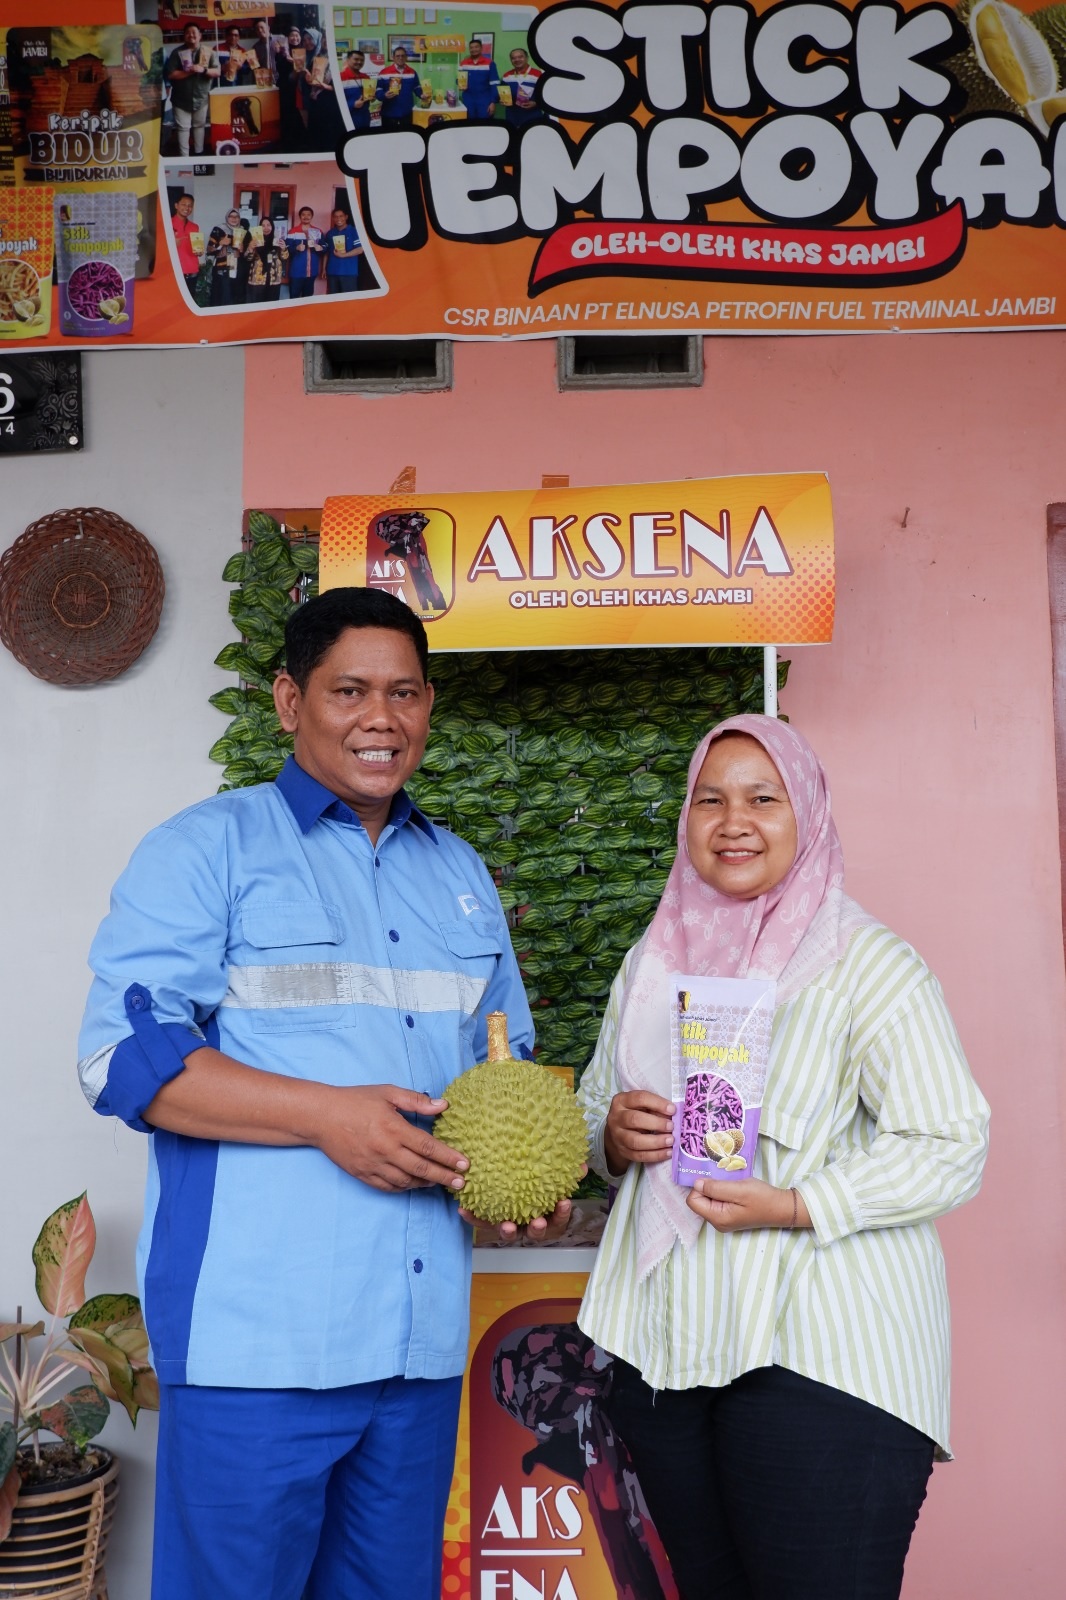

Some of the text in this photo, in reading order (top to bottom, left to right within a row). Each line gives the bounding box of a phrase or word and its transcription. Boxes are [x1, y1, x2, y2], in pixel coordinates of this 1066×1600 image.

[22, 46, 48, 58] JAMBI
[535, 5, 953, 114] STICK
[50, 110, 123, 131] Keripik
[29, 131, 144, 165] BIDUR
[45, 165, 128, 181] BIJI DURIAN
[344, 112, 1066, 241] TEMPOYA
[63, 226, 90, 241] Stik
[64, 237, 125, 256] Tempoyak
[571, 231, 925, 266] OLEH-OLEH KHAS JAMBI
[444, 296, 1057, 327] CSR BINAAN PT ELNUSA PETROFIN FUEL TERMINAL JAMBI
[468, 507, 793, 581] AKSENA
[370, 560, 406, 578] AKS
[510, 587, 752, 608] OLEH OLEH KHAS JAMBI
[682, 1043, 750, 1068] mpoyak
[481, 1484, 583, 1540] AKS
